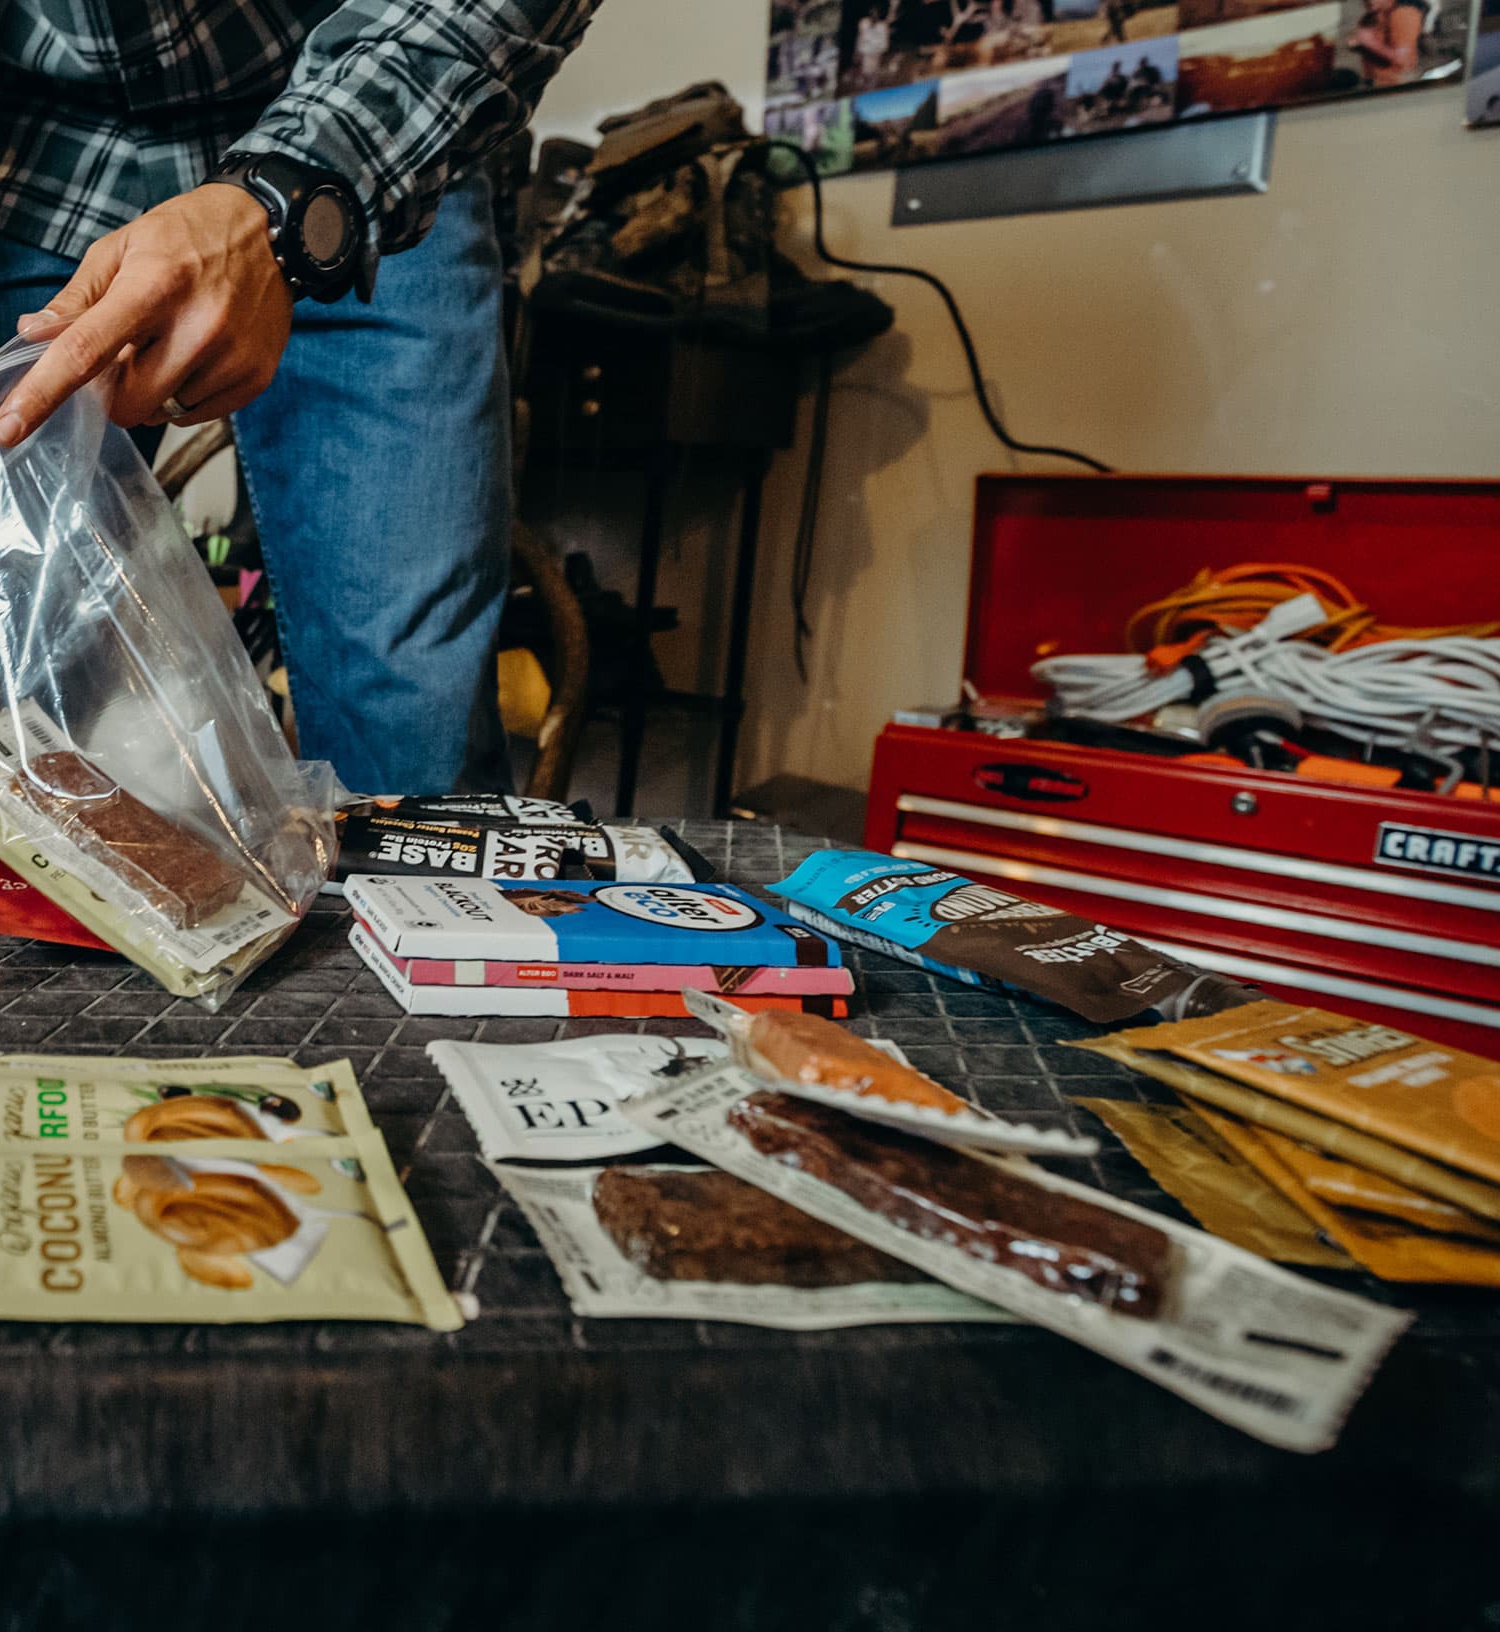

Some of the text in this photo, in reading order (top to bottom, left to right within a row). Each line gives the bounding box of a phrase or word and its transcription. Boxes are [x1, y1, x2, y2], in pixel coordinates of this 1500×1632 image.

[382, 834, 478, 853] 20g Protein Bar
[416, 823, 445, 833] Butter
[447, 827, 481, 839] Peanut
[377, 841, 478, 873] BASE
[1383, 831, 1500, 873] CRAFT
[434, 882, 493, 922] BLACKOUT
[623, 891, 679, 918] eco
[646, 888, 724, 925] alter
[563, 970, 636, 980] DARK SALT & MALT
[33, 1153, 85, 1294] COCONU
[90, 1204, 112, 1262] ALMOND
